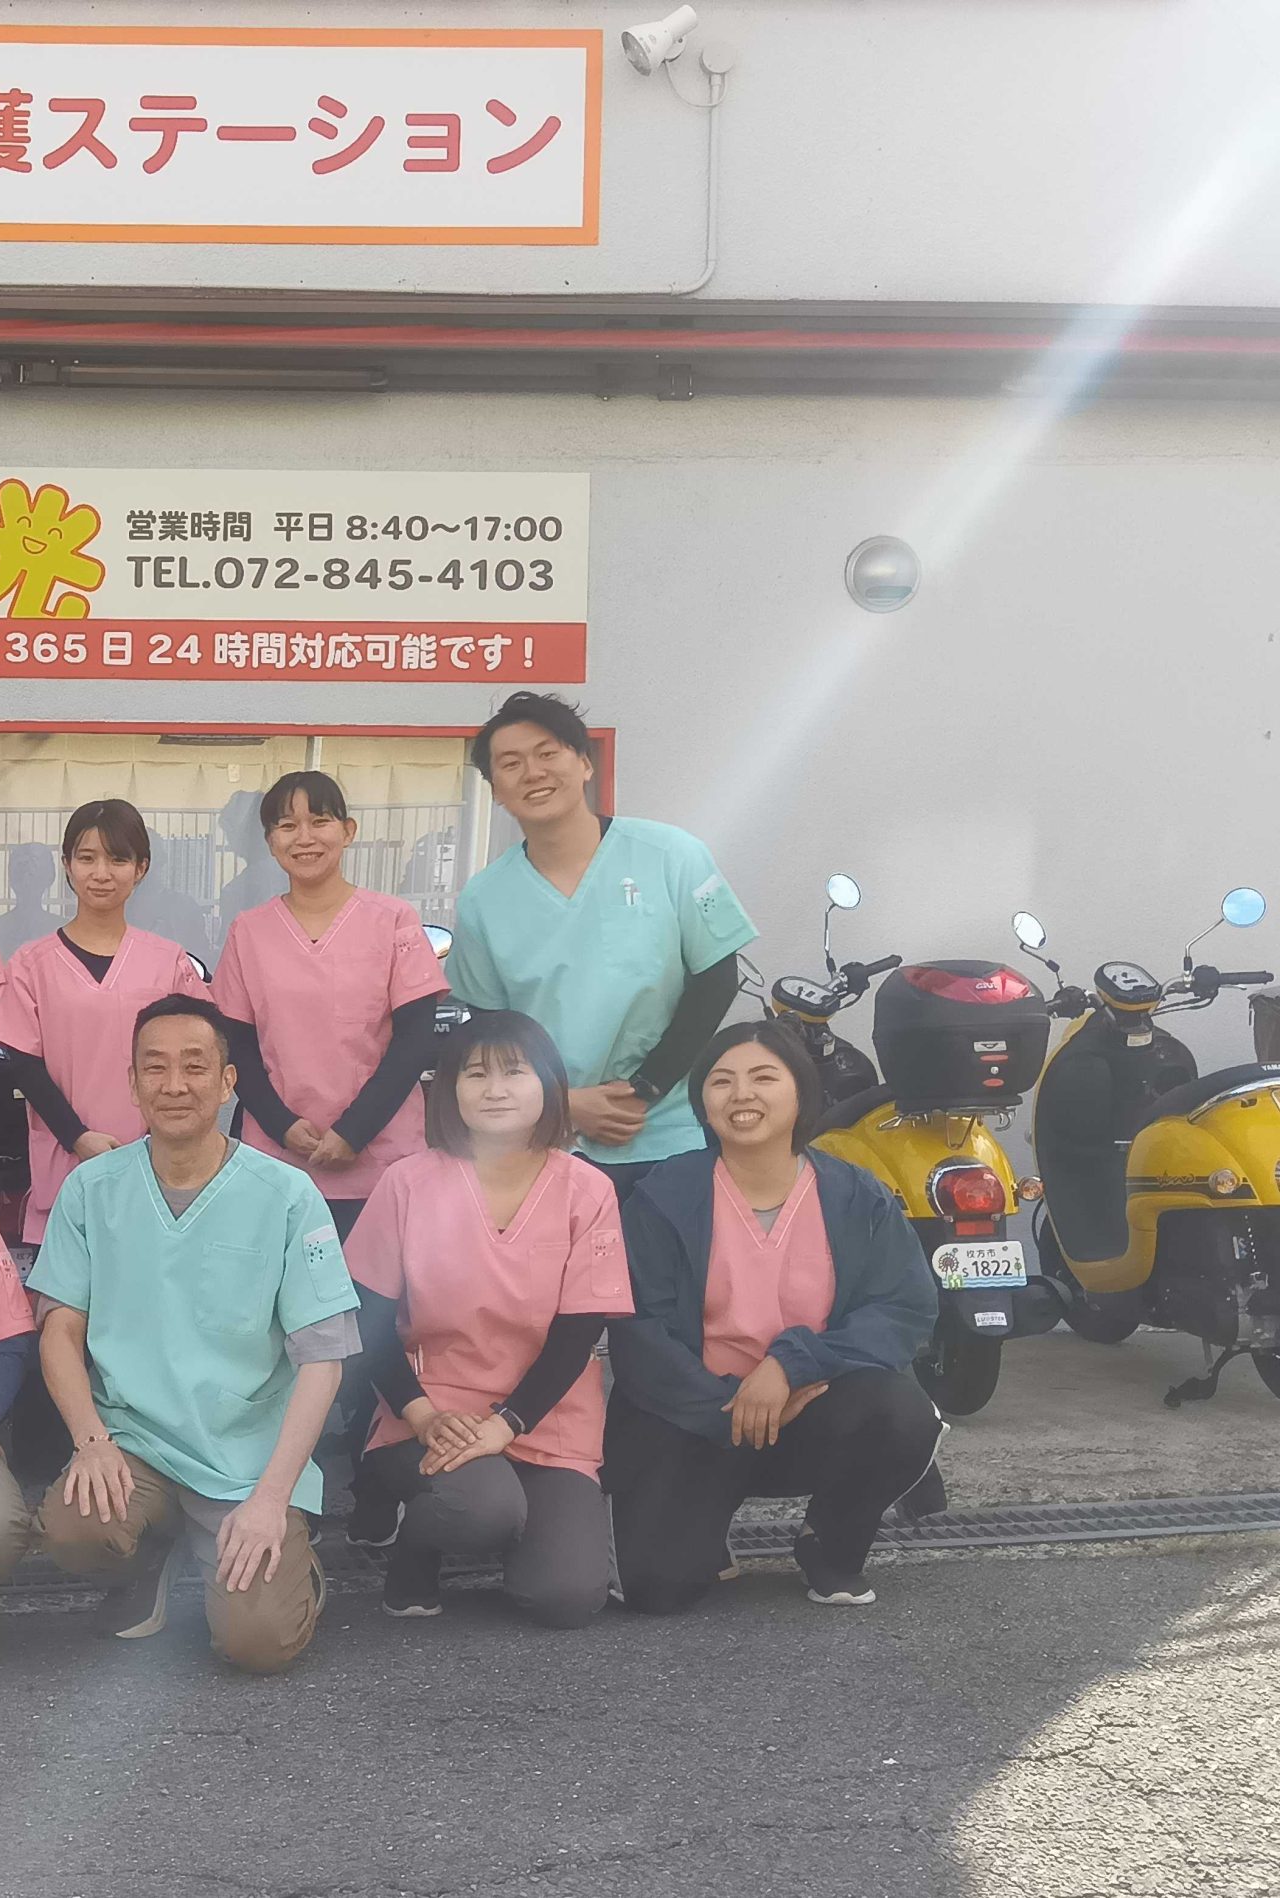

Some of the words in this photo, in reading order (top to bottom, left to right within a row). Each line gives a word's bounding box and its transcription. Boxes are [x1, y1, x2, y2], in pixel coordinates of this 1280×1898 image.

[126, 510, 252, 542] 営業時間
[273, 512, 333, 542] 平日
[126, 556, 554, 592] TEL.072-845-4103
[971, 1260, 1013, 1277] 1822
